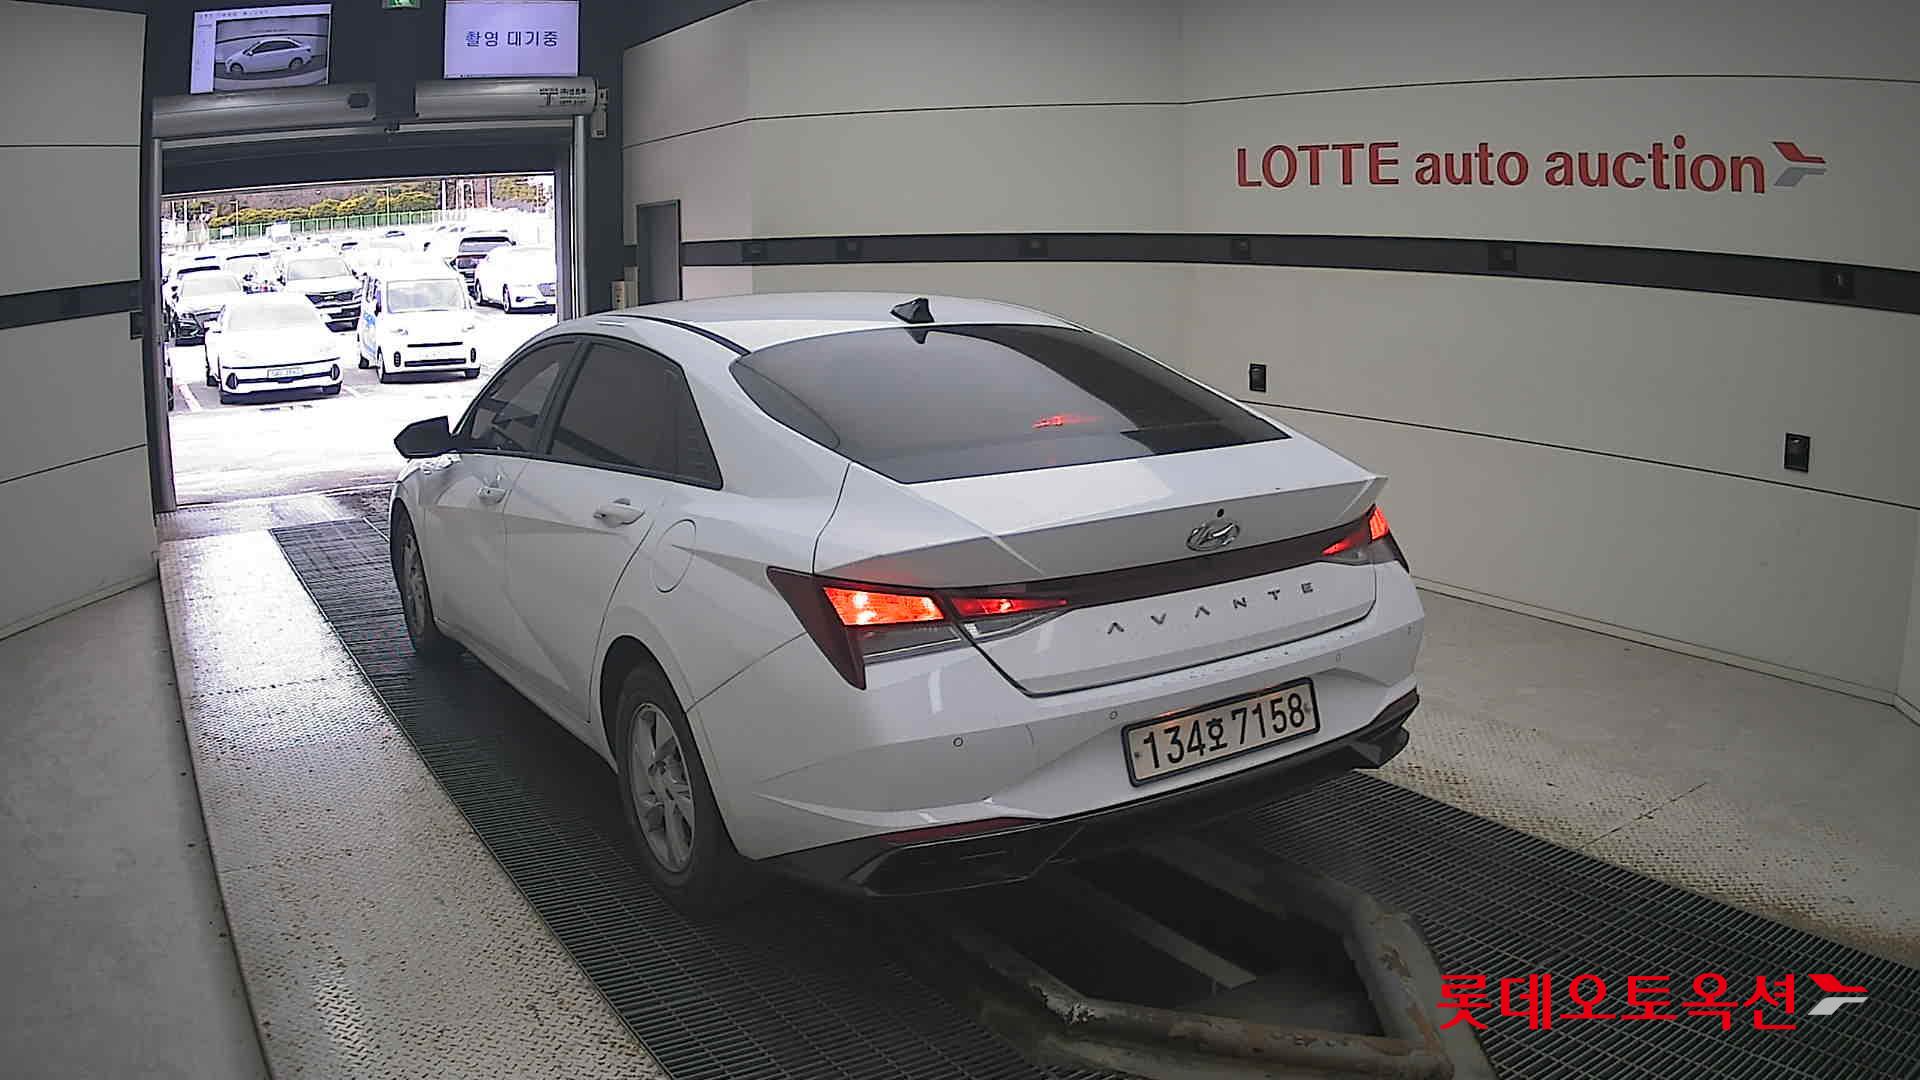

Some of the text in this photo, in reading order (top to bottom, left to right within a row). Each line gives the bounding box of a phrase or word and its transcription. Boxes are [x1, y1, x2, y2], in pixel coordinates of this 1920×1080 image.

[465, 31, 559, 48] 촬영 대기중
[1237, 136, 1765, 193] LOTTE auto auction
[1106, 581, 1315, 635] AVANTE
